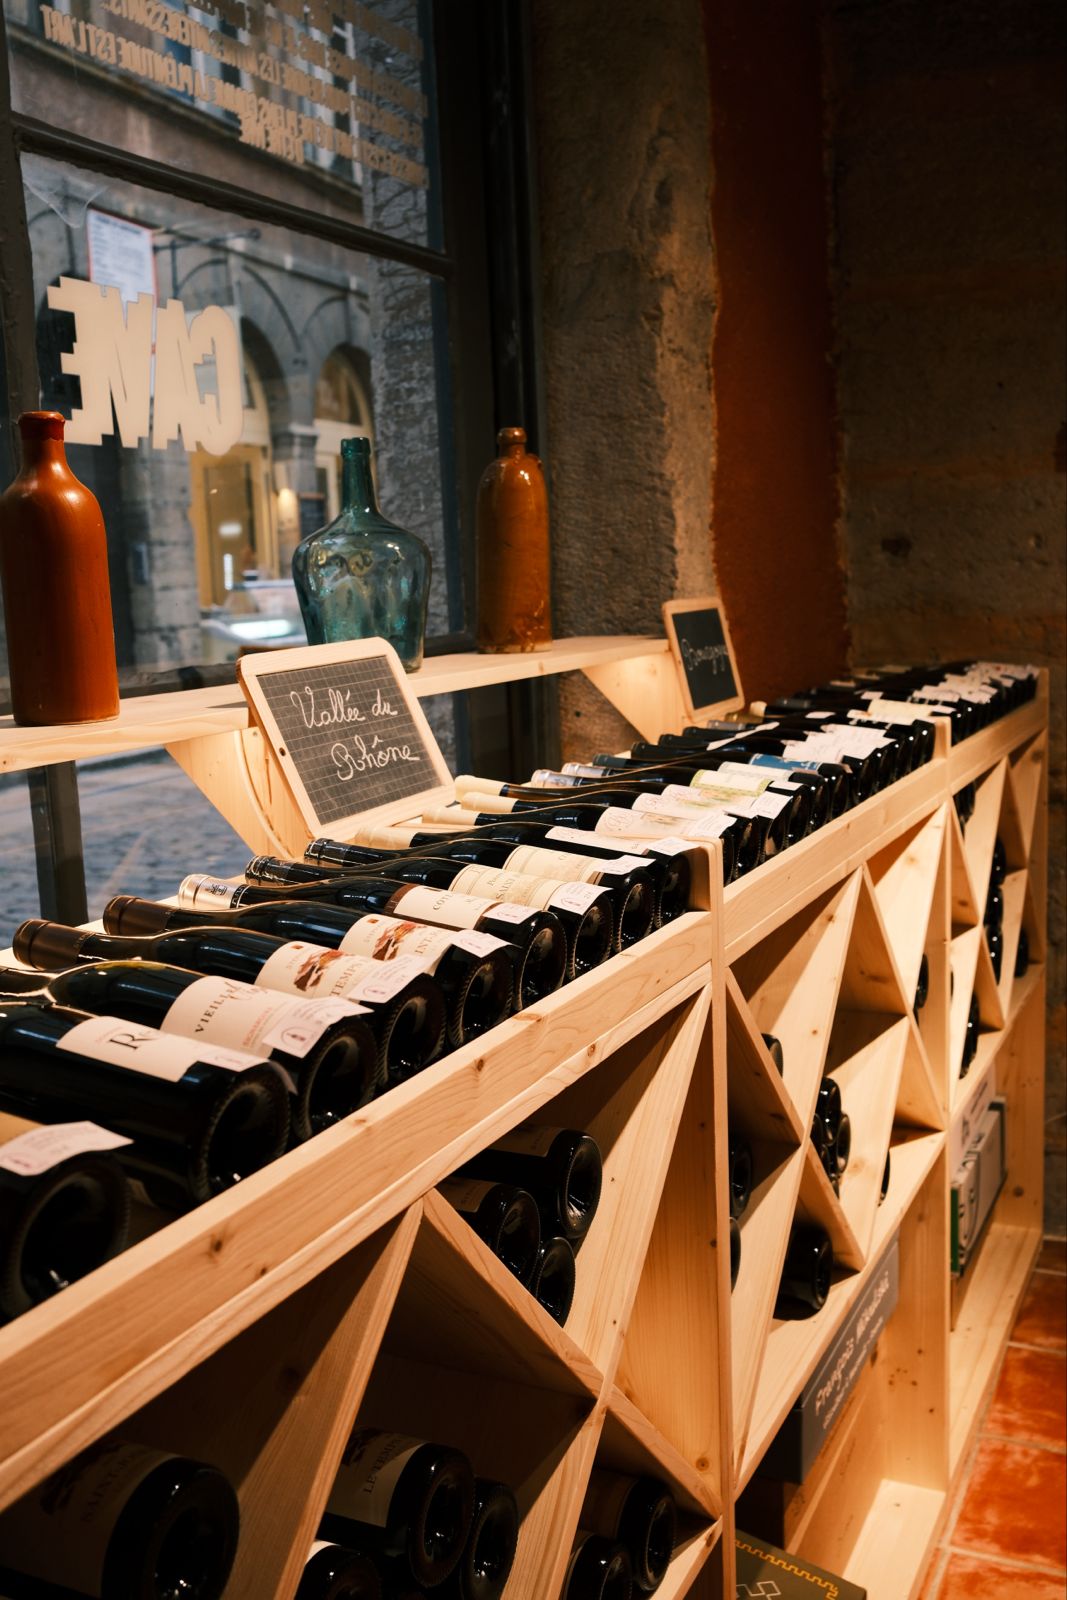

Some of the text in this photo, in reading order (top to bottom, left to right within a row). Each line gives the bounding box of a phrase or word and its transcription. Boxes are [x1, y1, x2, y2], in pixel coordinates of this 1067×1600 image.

[290, 686, 398, 729] Vallée du
[331, 734, 420, 781] Rhône
